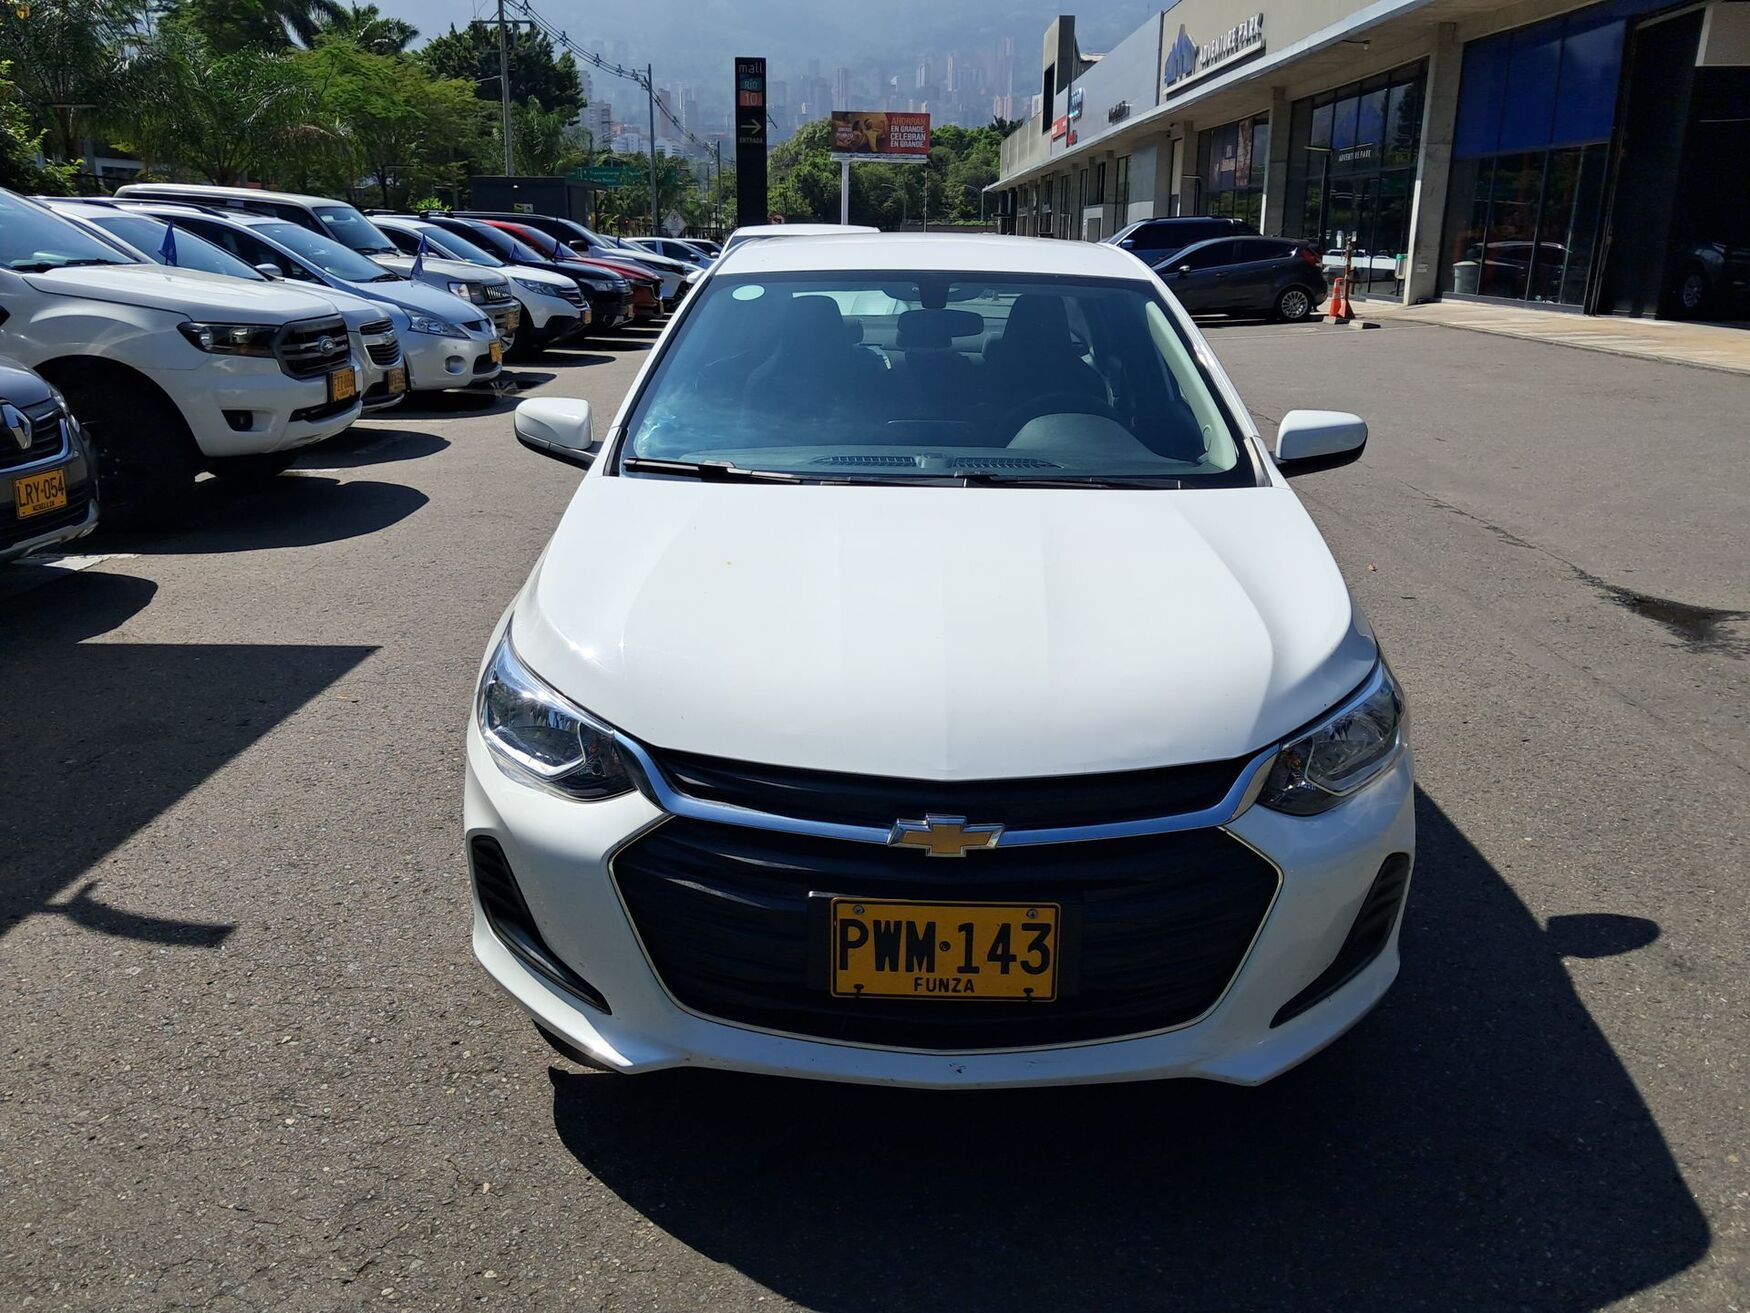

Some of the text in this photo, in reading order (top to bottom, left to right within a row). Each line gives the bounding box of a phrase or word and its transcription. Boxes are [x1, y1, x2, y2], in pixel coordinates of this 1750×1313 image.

[739, 62, 763, 73] mall
[890, 132, 926, 141] CELEBRAN
[890, 140, 899, 148] EN
[914, 977, 975, 993] FUNZA
